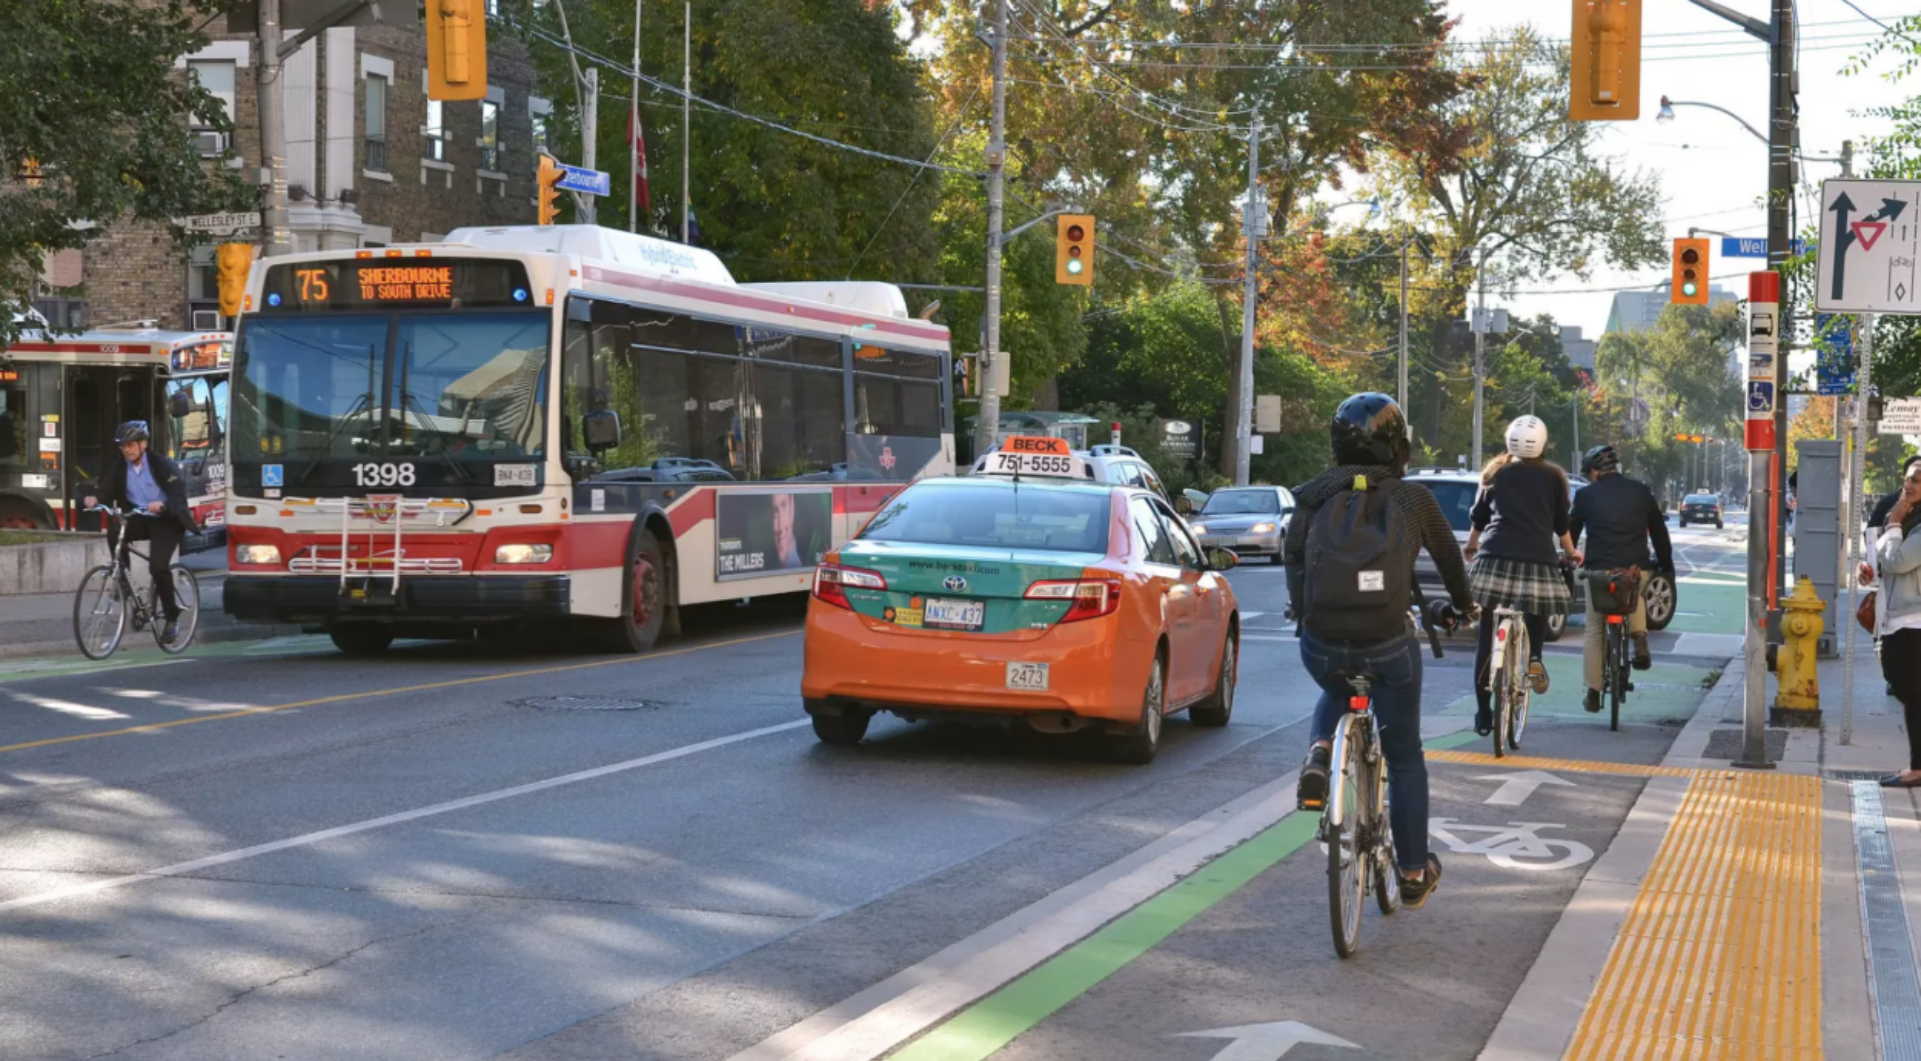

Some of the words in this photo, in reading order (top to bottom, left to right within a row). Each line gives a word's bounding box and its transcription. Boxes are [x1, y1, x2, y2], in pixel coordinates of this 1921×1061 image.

[191, 216, 235, 229] WELLESLEY
[358, 267, 452, 284] SHERBOURNE
[297, 269, 328, 301] 75
[361, 285, 374, 299] TO
[378, 285, 411, 299] SOUTH
[416, 284, 451, 299] DRIVE
[1014, 438, 1058, 452] BECK
[208, 464, 225, 478] 1009
[998, 454, 1071, 473] 751-5555
[352, 463, 415, 487] 1398
[719, 554, 734, 571] THE
[735, 552, 764, 570] MILLERS
[909, 560, 1000, 575] www.becktaxi.com
[1011, 668, 1043, 685] 2473
